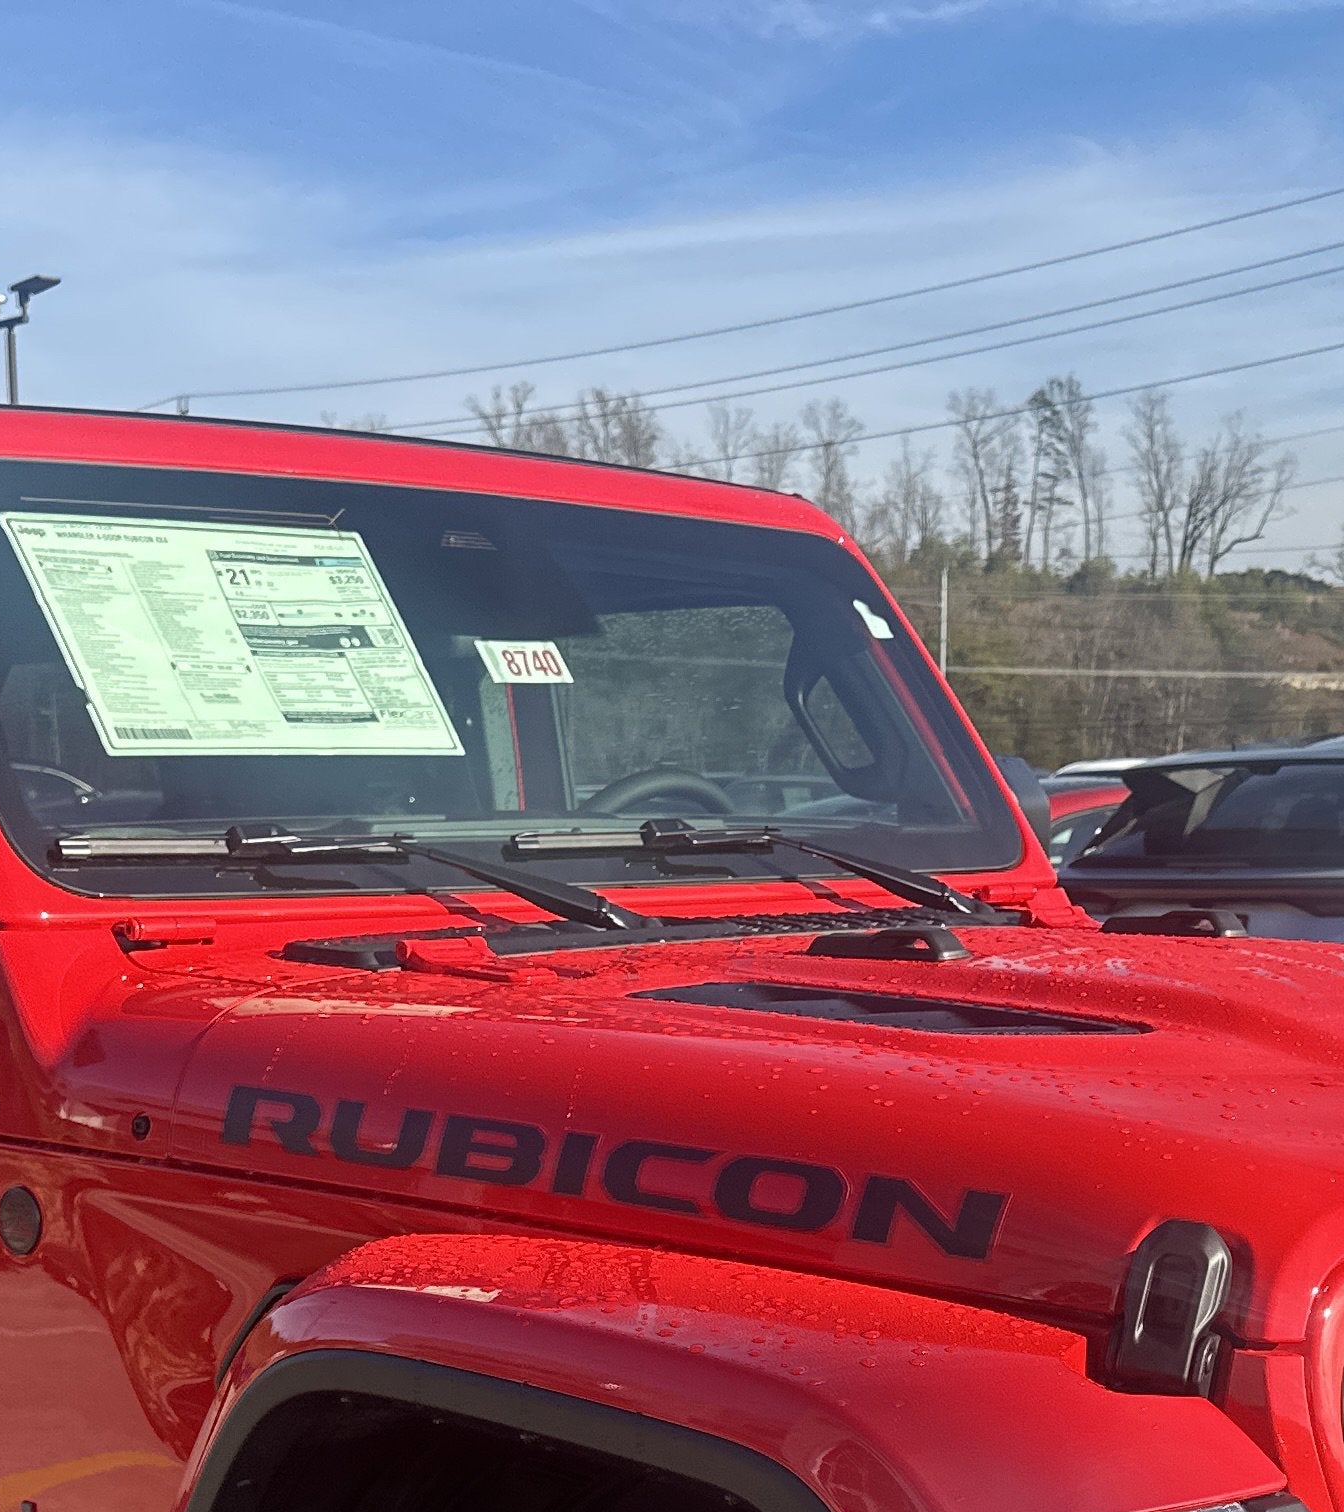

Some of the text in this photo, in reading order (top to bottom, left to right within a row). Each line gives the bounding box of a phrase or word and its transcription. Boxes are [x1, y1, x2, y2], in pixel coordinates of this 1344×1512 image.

[17, 525, 46, 537] Jeep
[225, 568, 250, 585] 21
[501, 650, 562, 677] 8740
[220, 1084, 1014, 1261] RUBICON
